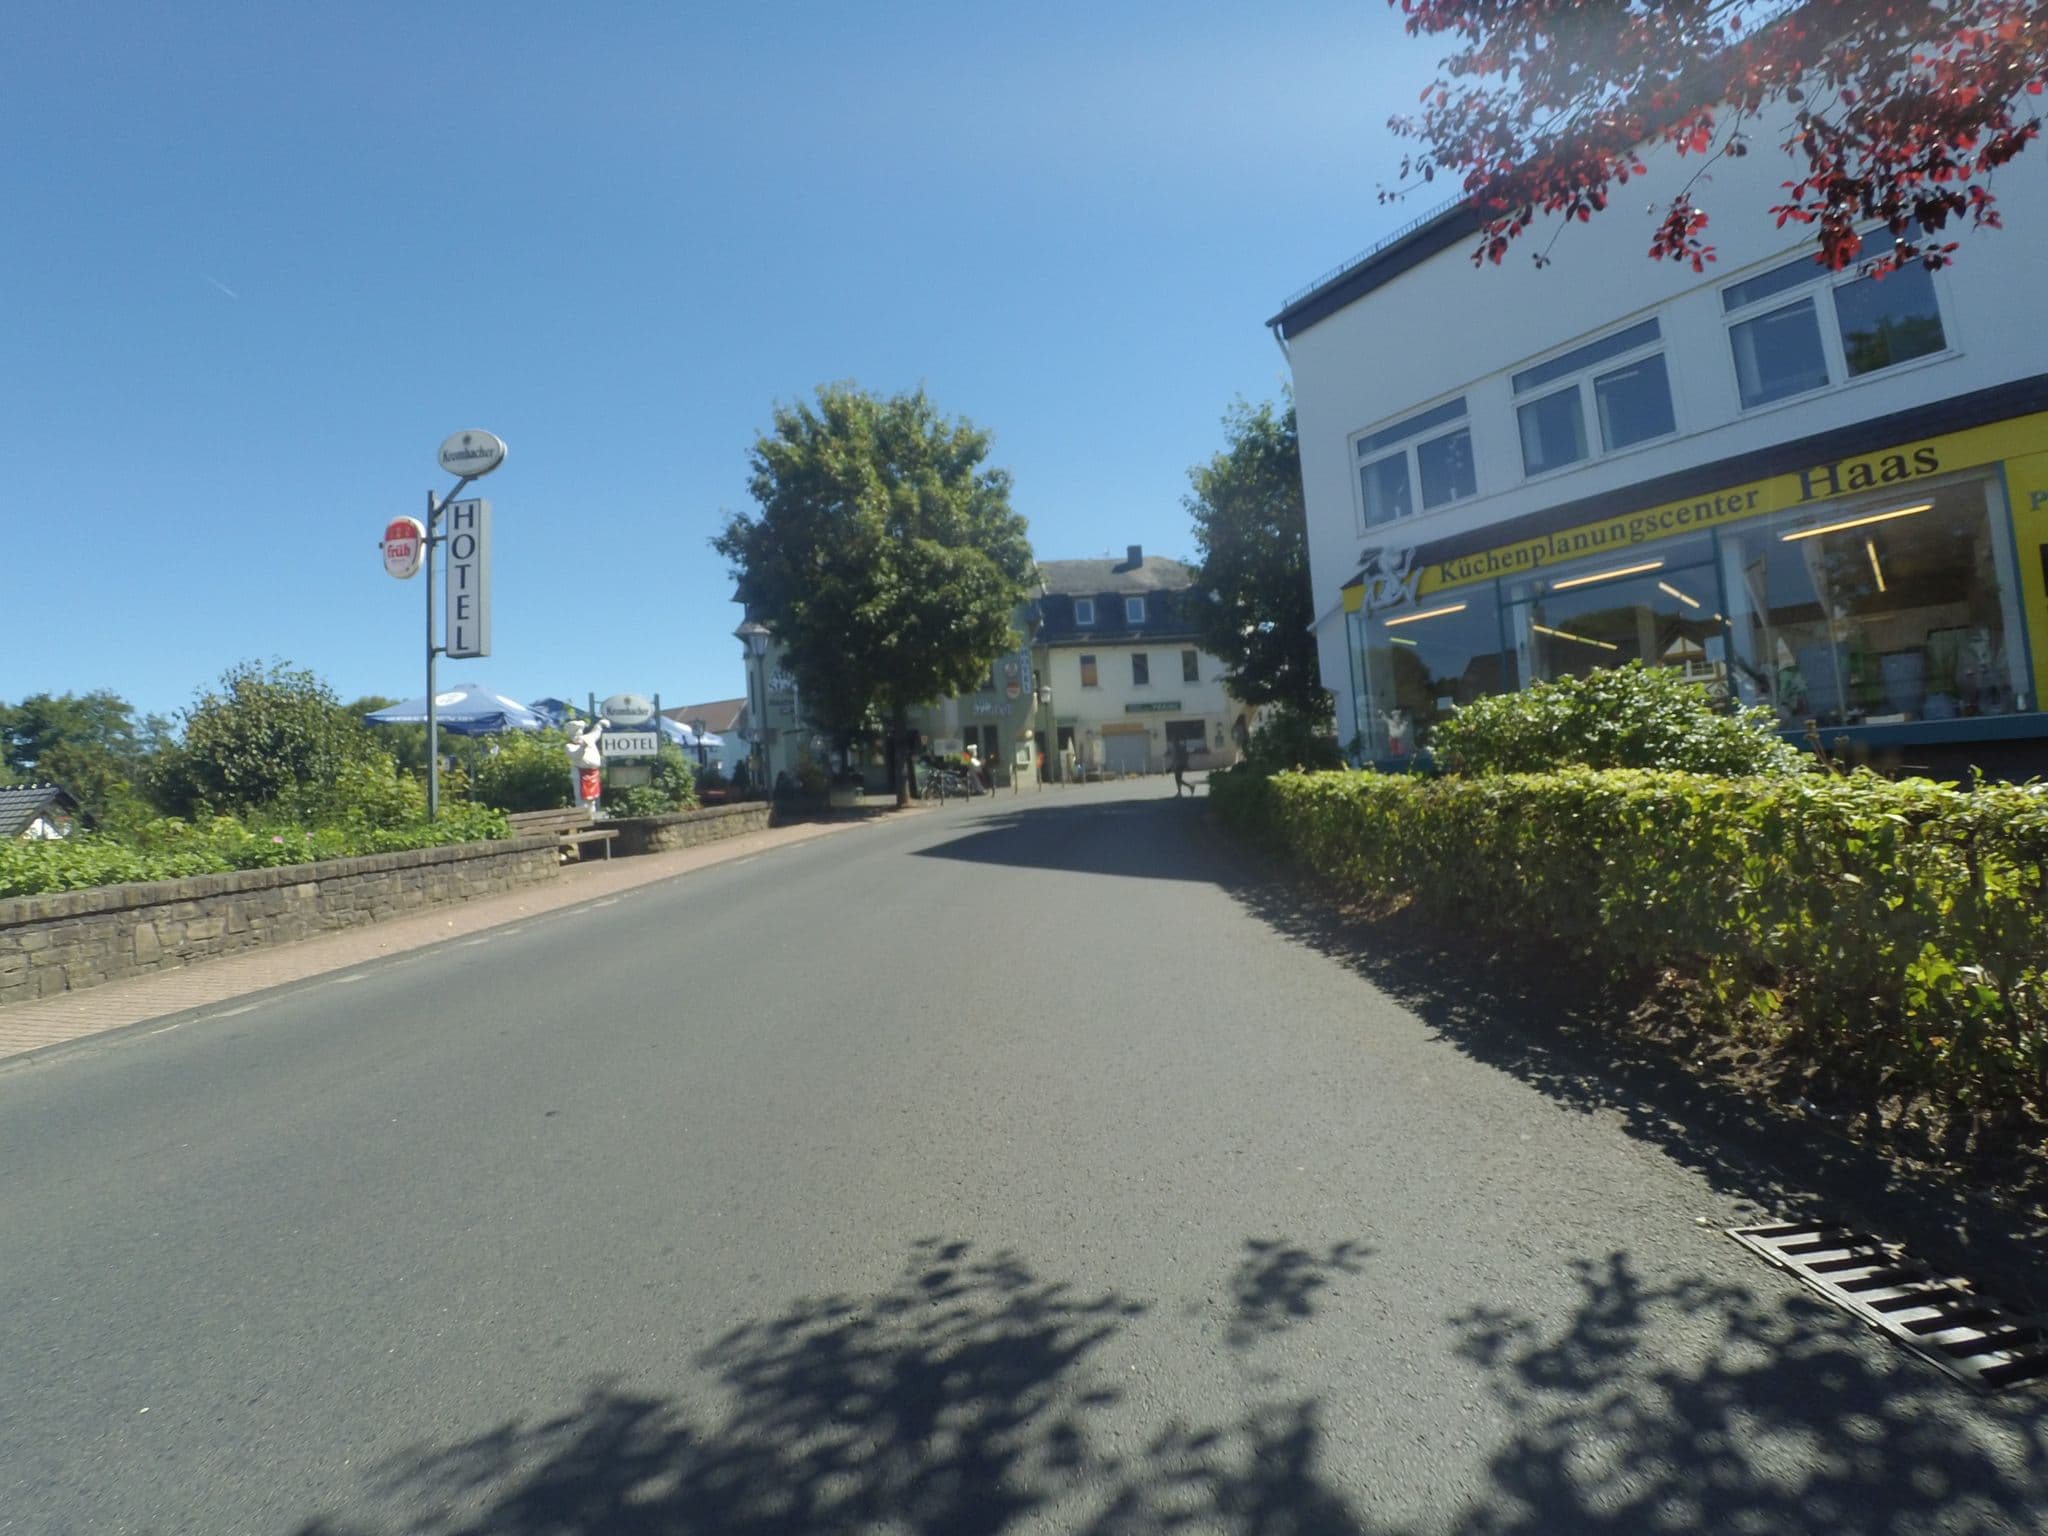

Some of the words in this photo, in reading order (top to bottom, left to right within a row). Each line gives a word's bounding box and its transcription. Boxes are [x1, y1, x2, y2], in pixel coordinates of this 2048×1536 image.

[387, 544, 411, 559] früh
[1439, 487, 1760, 585] Küchenplanungscenter
[1800, 445, 1939, 503] Haas
[451, 503, 476, 652] HOTEL
[604, 737, 655, 751] HOTEL
